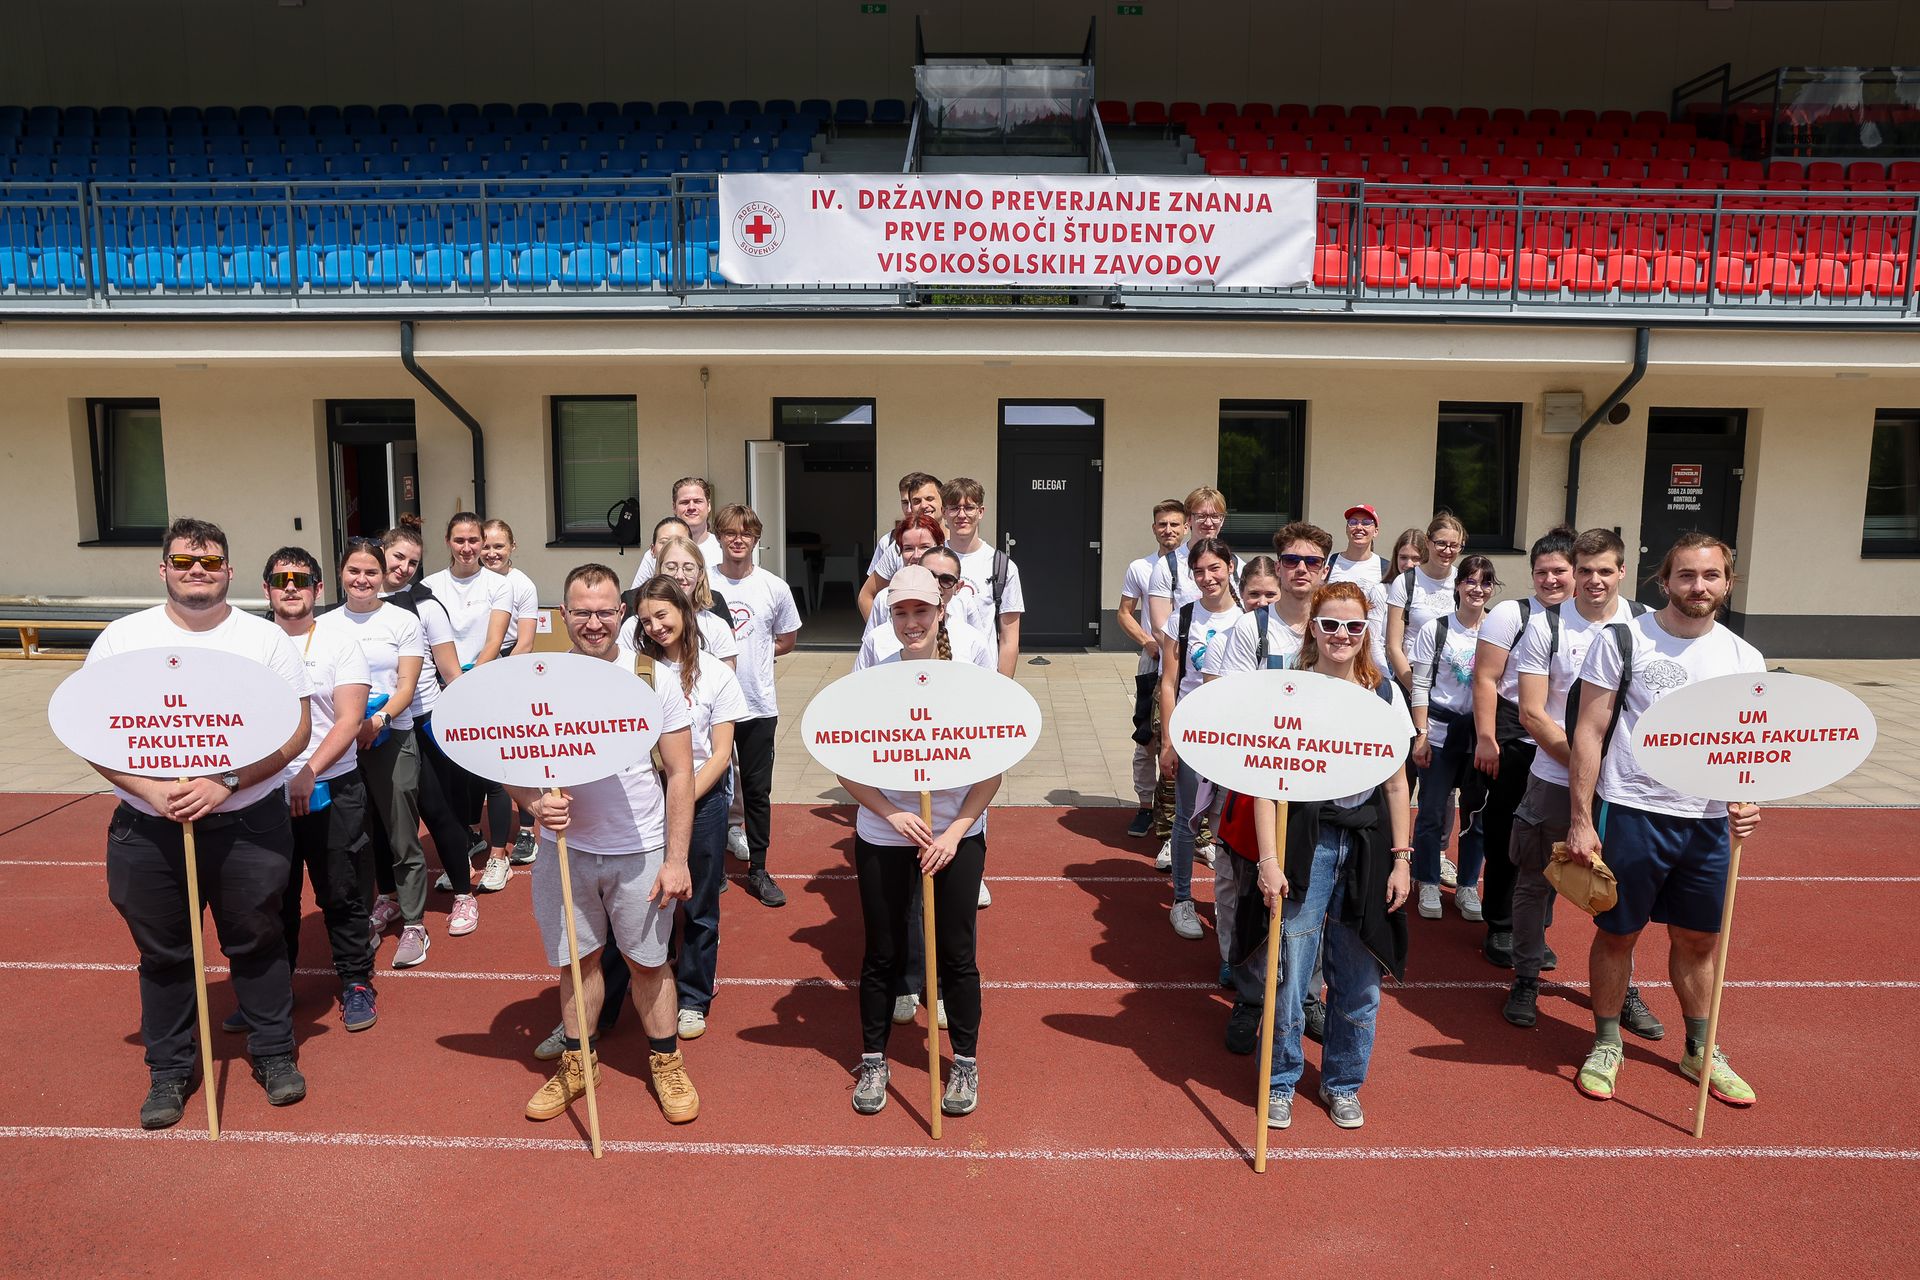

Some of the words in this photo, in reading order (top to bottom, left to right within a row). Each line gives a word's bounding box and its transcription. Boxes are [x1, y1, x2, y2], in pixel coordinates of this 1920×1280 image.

[811, 189, 843, 210] IV.
[858, 183, 984, 211] DRŽAVNO
[992, 190, 1161, 213] PREVERJANJE
[1169, 191, 1273, 214] ZNANJA
[737, 202, 760, 221] RDEČI
[884, 221, 946, 242] PRVE
[953, 216, 1056, 243] POMOČI
[1063, 216, 1215, 245] ŠTUDENTOV
[740, 240, 779, 255] SLOVENIJE
[878, 248, 1086, 275] VISOKOŠOLSKIH
[1093, 254, 1221, 276] ZAVODOV
[1032, 479, 1067, 490] DELEGAT
[163, 694, 187, 709] UL
[531, 703, 554, 718] UL
[910, 707, 933, 722] UL
[1738, 709, 1768, 725] UM
[110, 713, 245, 730] ZDRAVSTVENA
[444, 723, 550, 742] MEDICINSKA
[553, 717, 649, 737] FAKULTETA
[1273, 715, 1303, 731] UM
[127, 733, 229, 750] FAKULTETA
[815, 727, 927, 745] MEDICINSKA
[932, 724, 1027, 741] FAKULTETA
[1643, 730, 1756, 748] MEDICINSKA
[1761, 727, 1861, 744] FAKULTETA
[500, 741, 597, 761] LJUBLJANA
[1182, 729, 1291, 751] MEDICINSKA
[1296, 737, 1394, 758] FAKULTETA
[127, 754, 232, 770] LJUBLJANA
[872, 746, 971, 763] LJUBLJANA
[1706, 749, 1792, 766] MARIBOR
[544, 765, 556, 779] I.
[1244, 754, 1328, 773] MARIBOR
[914, 768, 930, 783] II.
[1278, 777, 1289, 791] I.
[1738, 770, 1755, 785] II.
